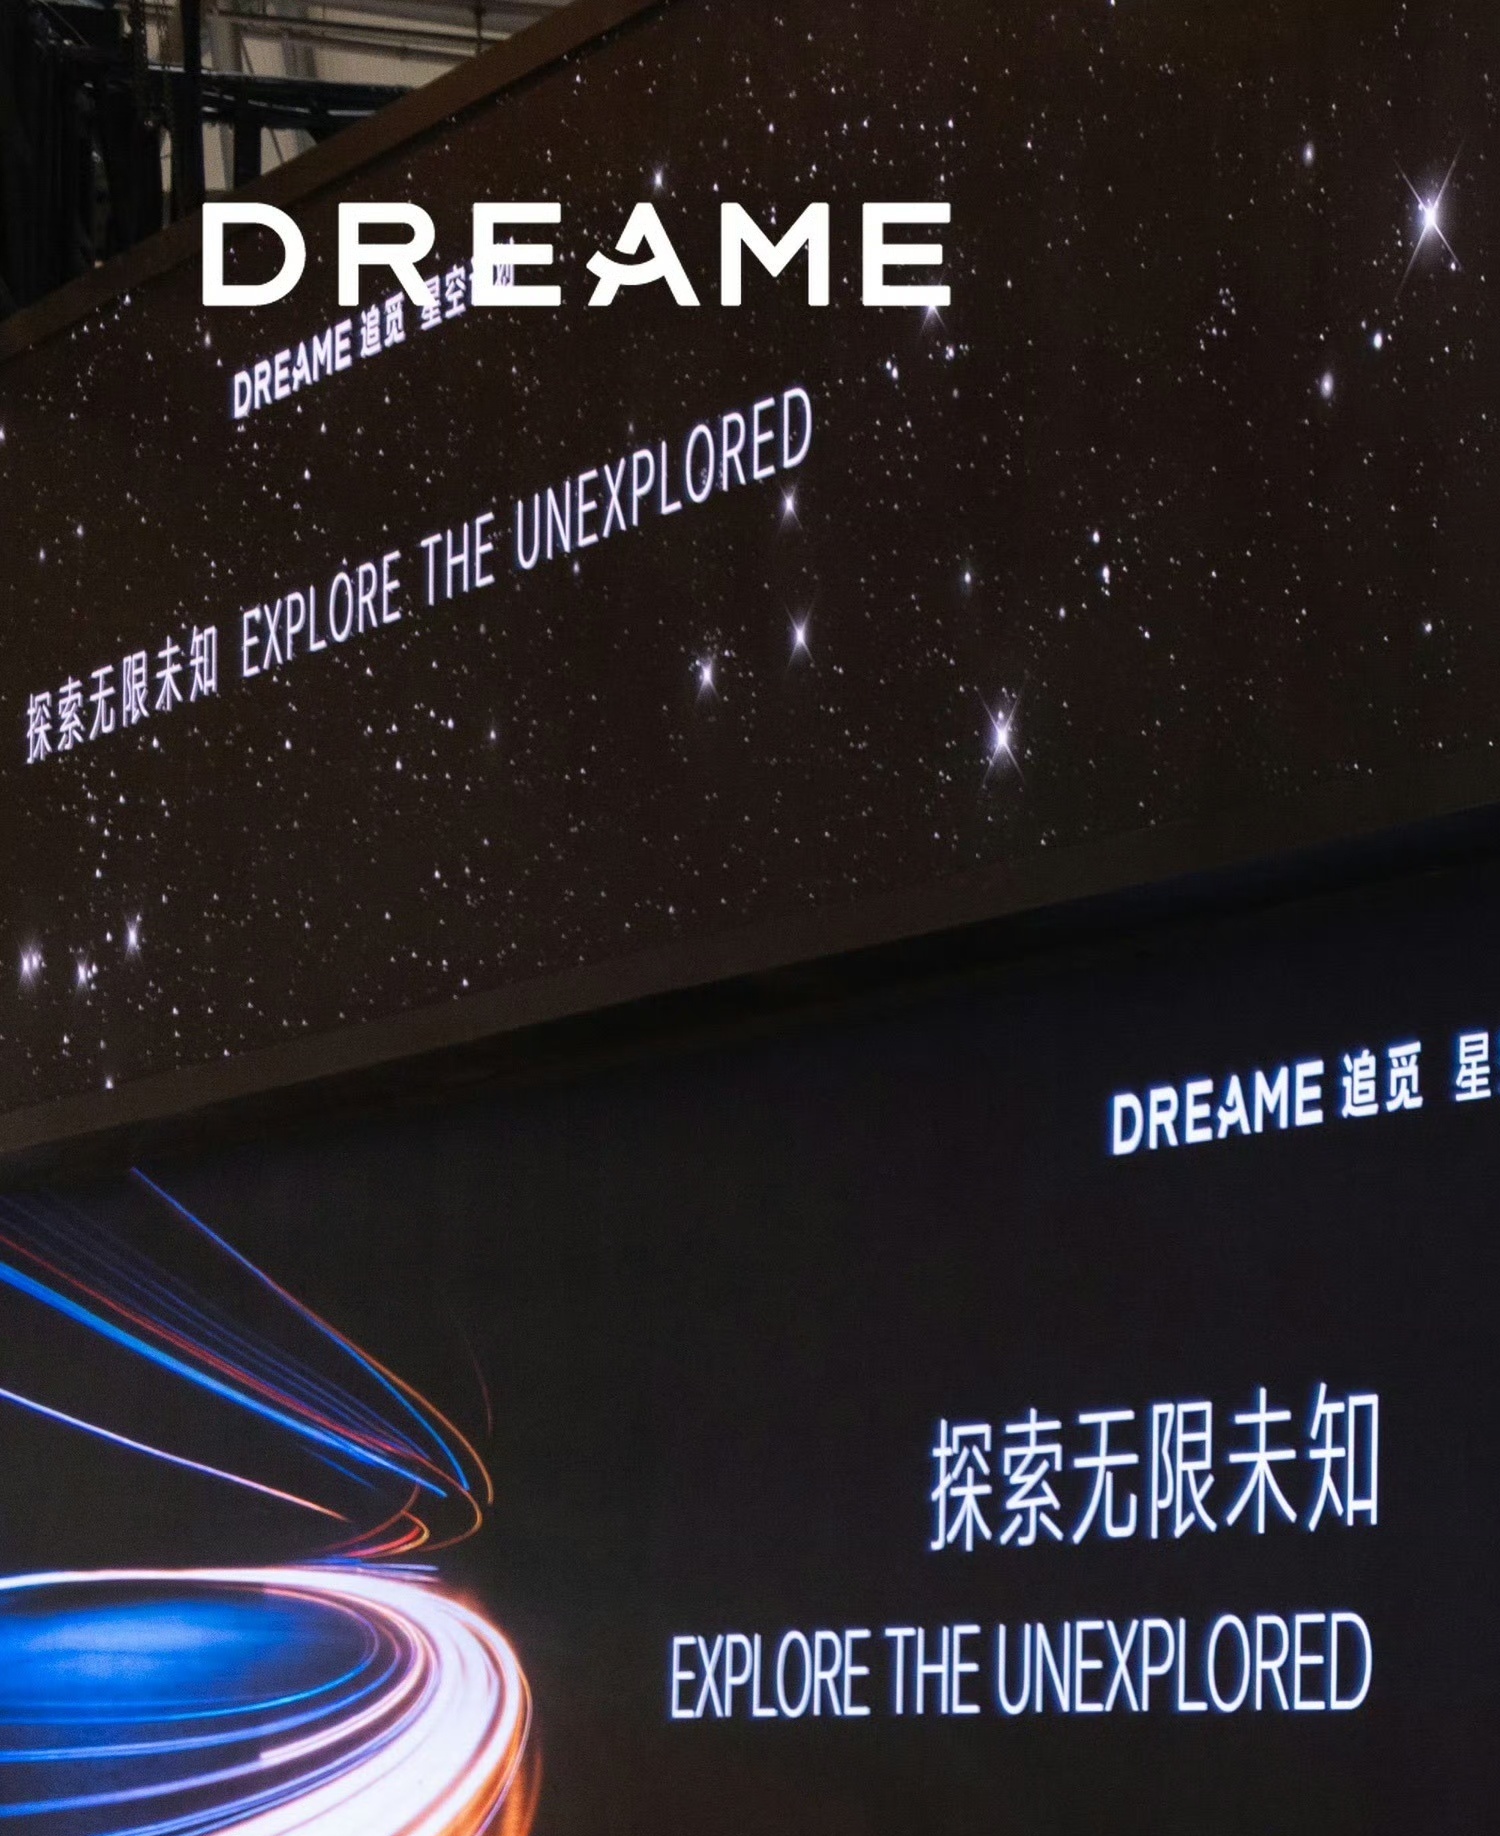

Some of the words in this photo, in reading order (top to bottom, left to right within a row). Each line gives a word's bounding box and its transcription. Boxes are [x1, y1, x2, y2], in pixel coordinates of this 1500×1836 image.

[233, 318, 352, 419] DREAME
[26, 625, 218, 764] 探索无限未知
[242, 549, 401, 678] EXPLORE
[420, 511, 495, 606] THE
[516, 388, 813, 571] UNEXPLORED
[1109, 1059, 1325, 1156] DREAME
[1338, 1041, 1424, 1119] 追觅
[928, 1381, 1380, 1553] 探索无限未知
[668, 1627, 872, 1720] EXPLORE
[883, 1623, 982, 1715] THE
[994, 1610, 1373, 1716] UNEXPLORED
